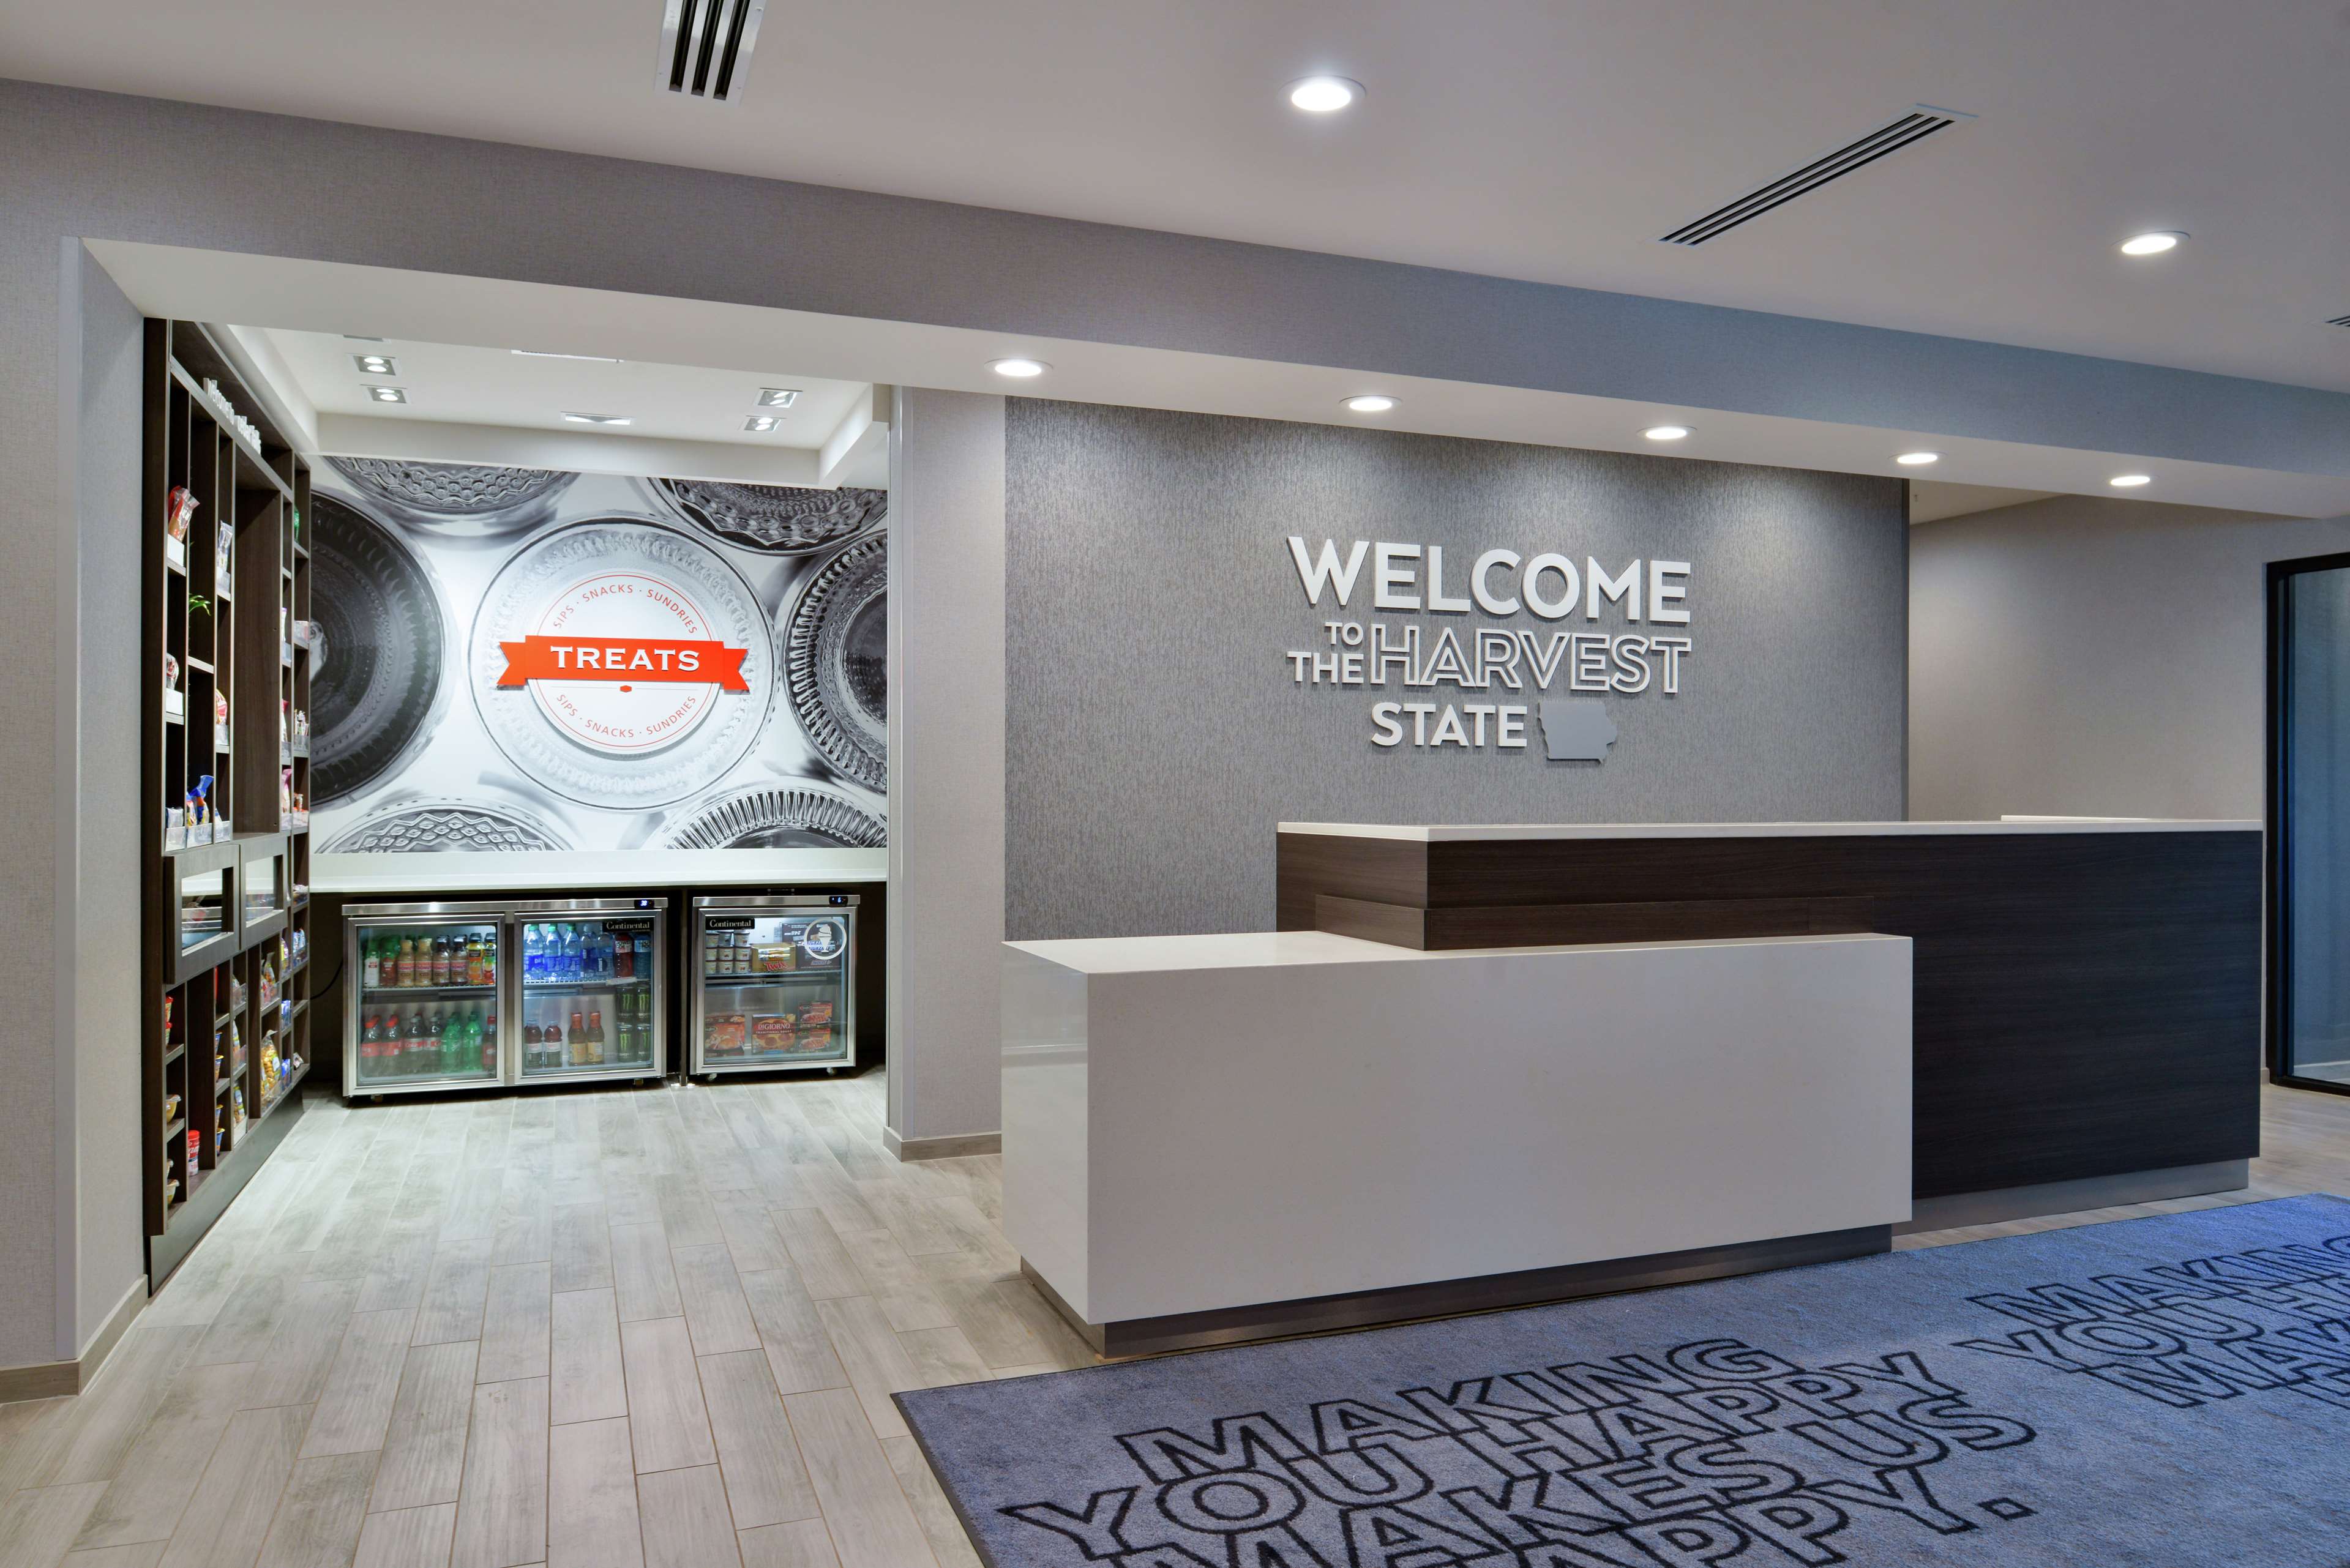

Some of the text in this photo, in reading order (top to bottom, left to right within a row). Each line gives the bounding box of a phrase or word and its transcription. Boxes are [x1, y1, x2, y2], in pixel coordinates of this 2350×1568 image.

[1287, 536, 1691, 623] WELCOME
[552, 583, 698, 634] SIPS SNACKS SUNDRIES
[1324, 621, 1364, 646] TO
[550, 646, 700, 672] TREATS
[1287, 623, 1692, 694] THE HARVEST
[556, 693, 697, 738] SIPS SNACKS SUNDRIES
[1371, 702, 1528, 747] STATE
[606, 921, 650, 930] Continental
[709, 919, 752, 928] Continental
[1949, 1302, 2265, 1373] YOU
[1114, 1337, 1806, 1485] MAKING
[1784, 1395, 2037, 1469] US
[996, 1350, 1971, 1561] YOU HAPPY
